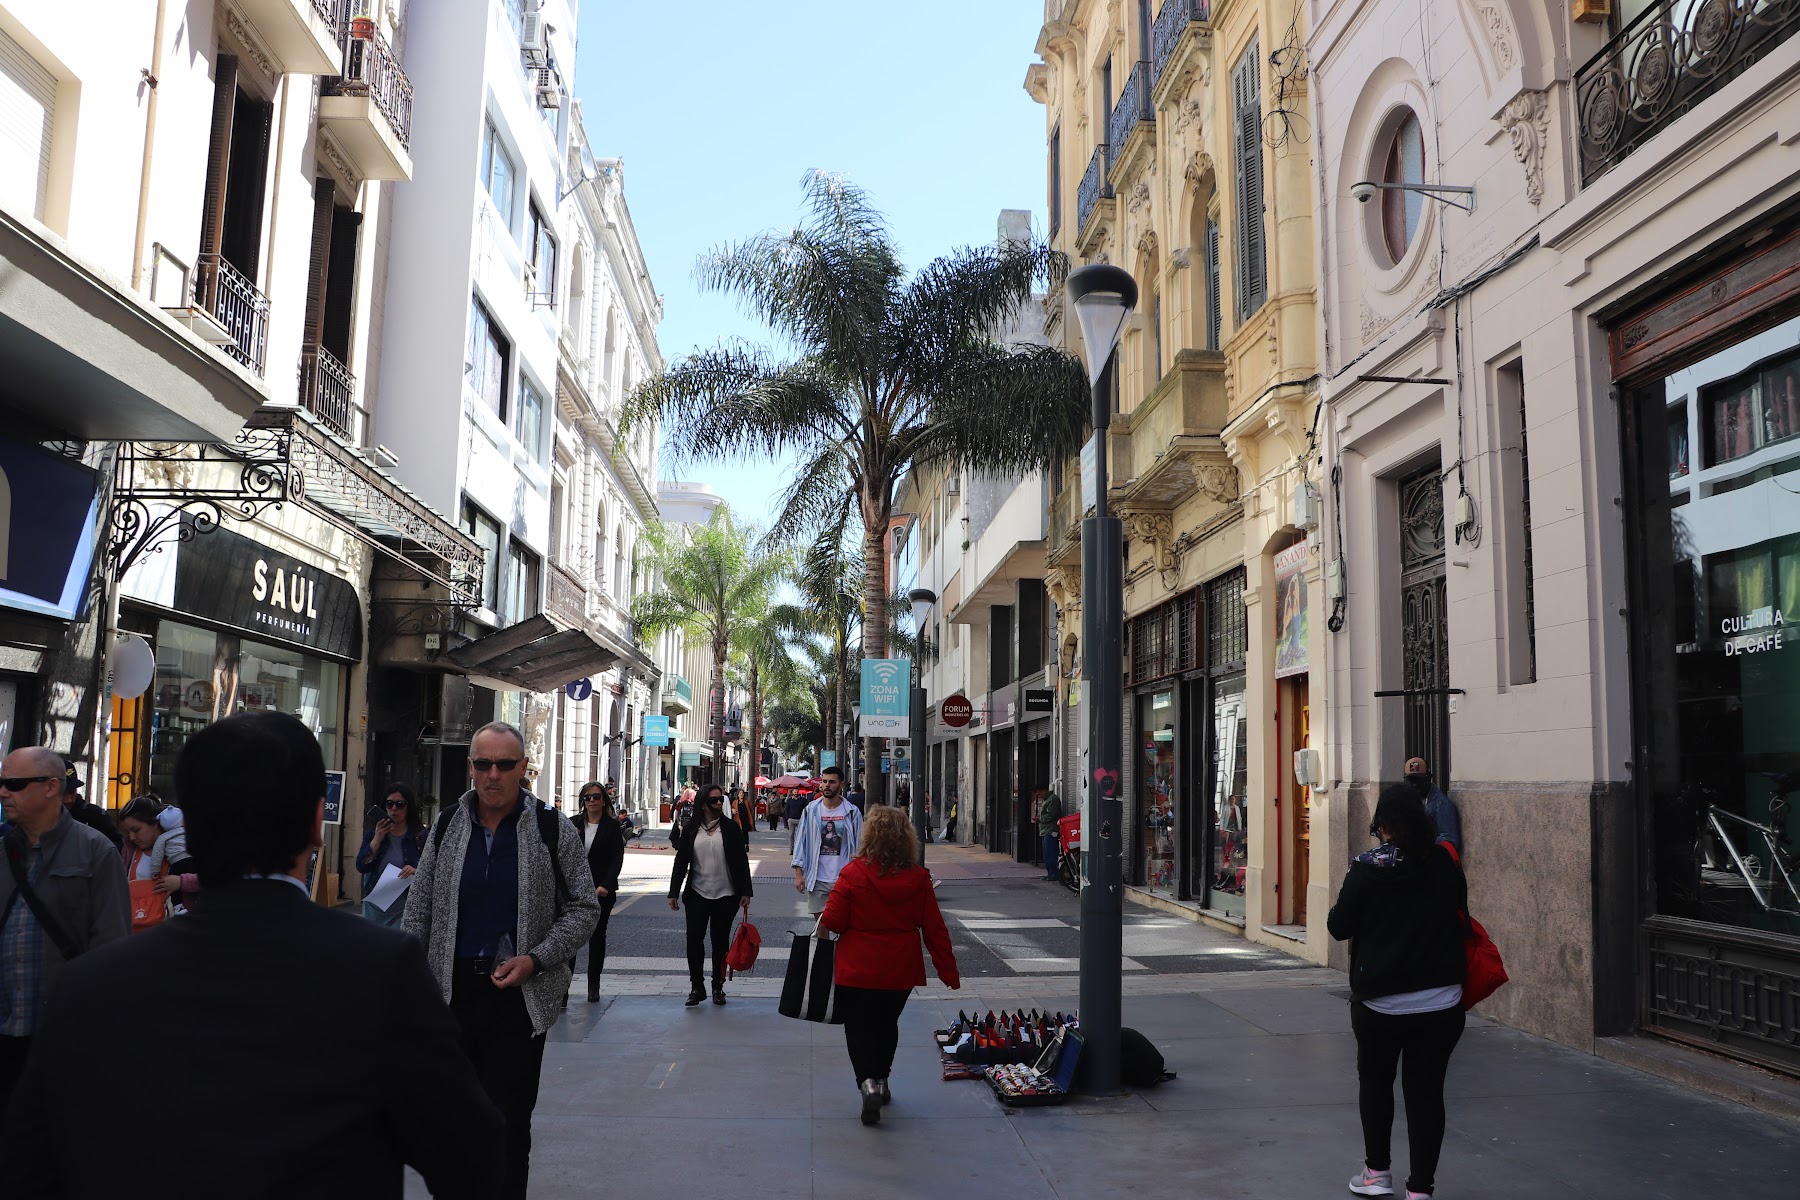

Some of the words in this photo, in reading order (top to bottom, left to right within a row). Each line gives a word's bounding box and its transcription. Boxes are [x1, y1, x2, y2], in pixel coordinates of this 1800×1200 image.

[252, 559, 317, 619] SAÚL
[256, 612, 310, 635] PERFUMERÍA
[1721, 609, 1784, 634] CULTURA
[1725, 640, 1742, 657] DE
[1746, 629, 1783, 654] CAFÉ
[870, 685, 900, 695] ZONA
[874, 694, 896, 704] WIFI
[944, 705, 970, 713] FORUM
